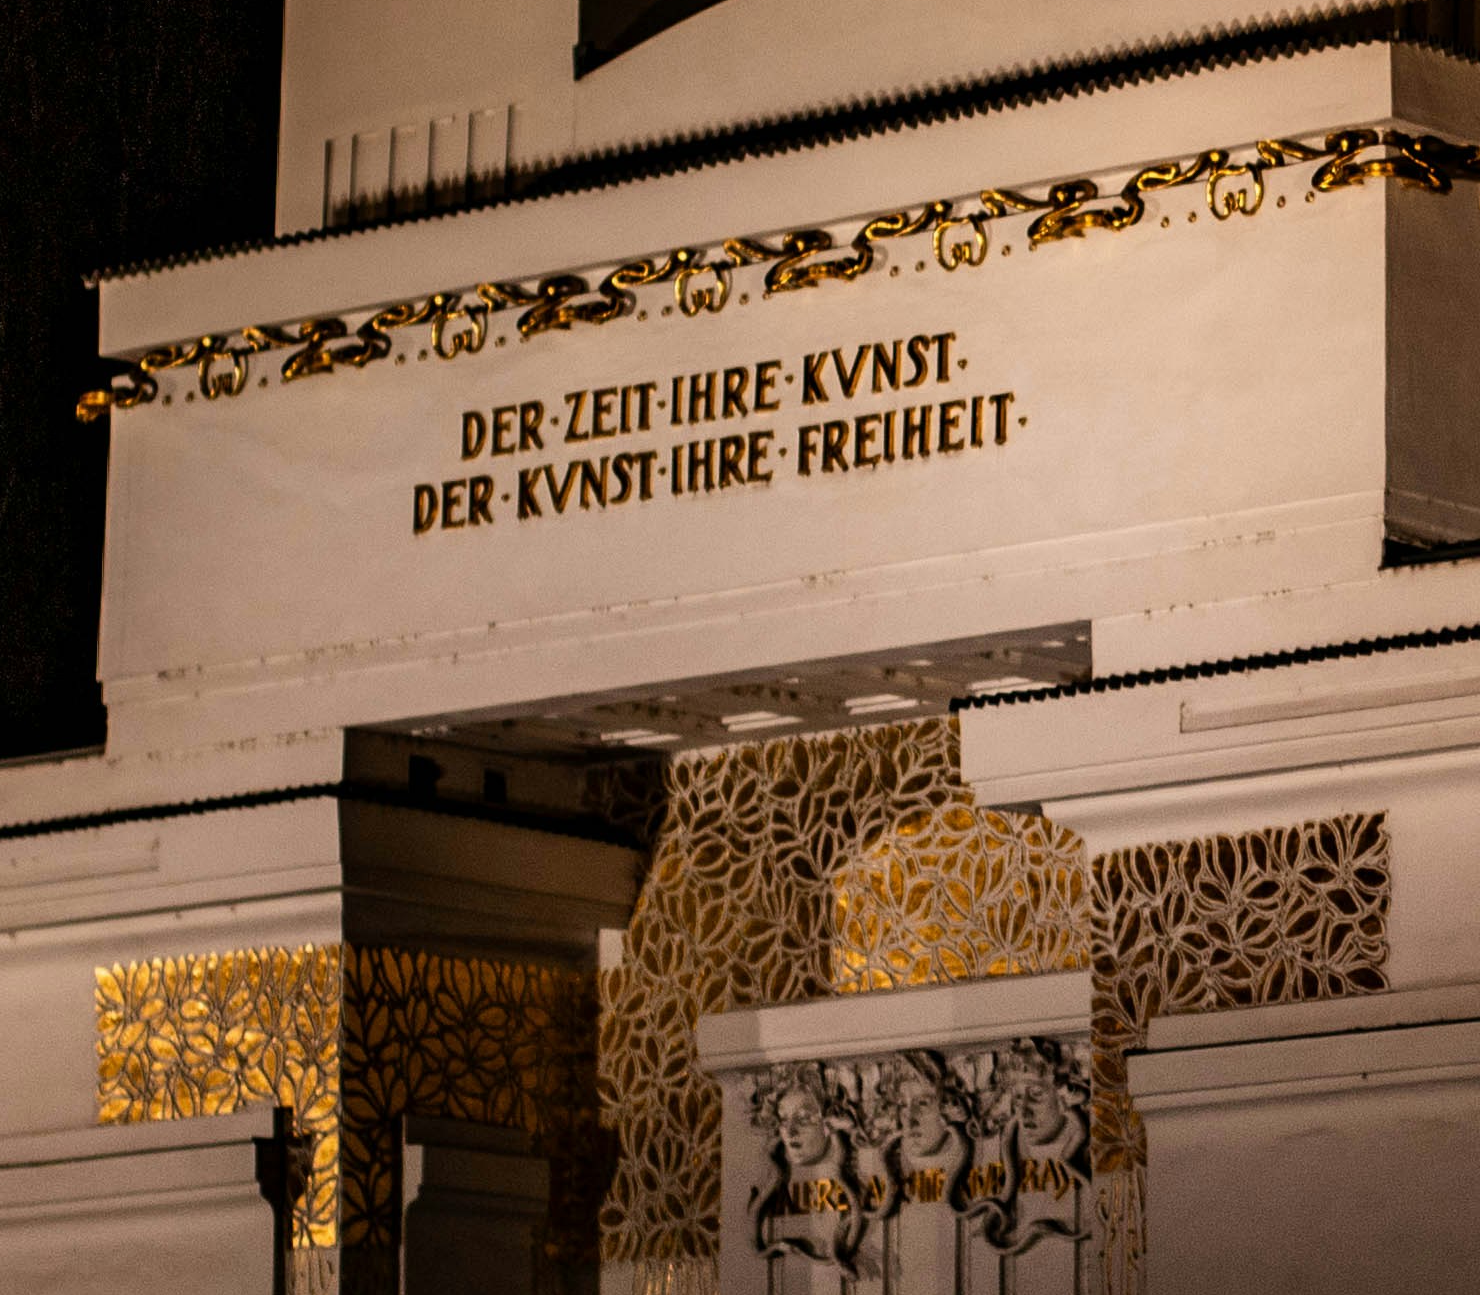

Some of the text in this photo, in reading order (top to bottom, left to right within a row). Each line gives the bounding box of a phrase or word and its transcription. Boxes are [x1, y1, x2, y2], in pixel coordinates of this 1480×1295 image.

[460, 401, 544, 461] DER
[563, 382, 658, 443] ZEIT
[670, 360, 782, 425] IHRE
[412, 475, 494, 535] DER
[671, 430, 775, 496] IHRE
